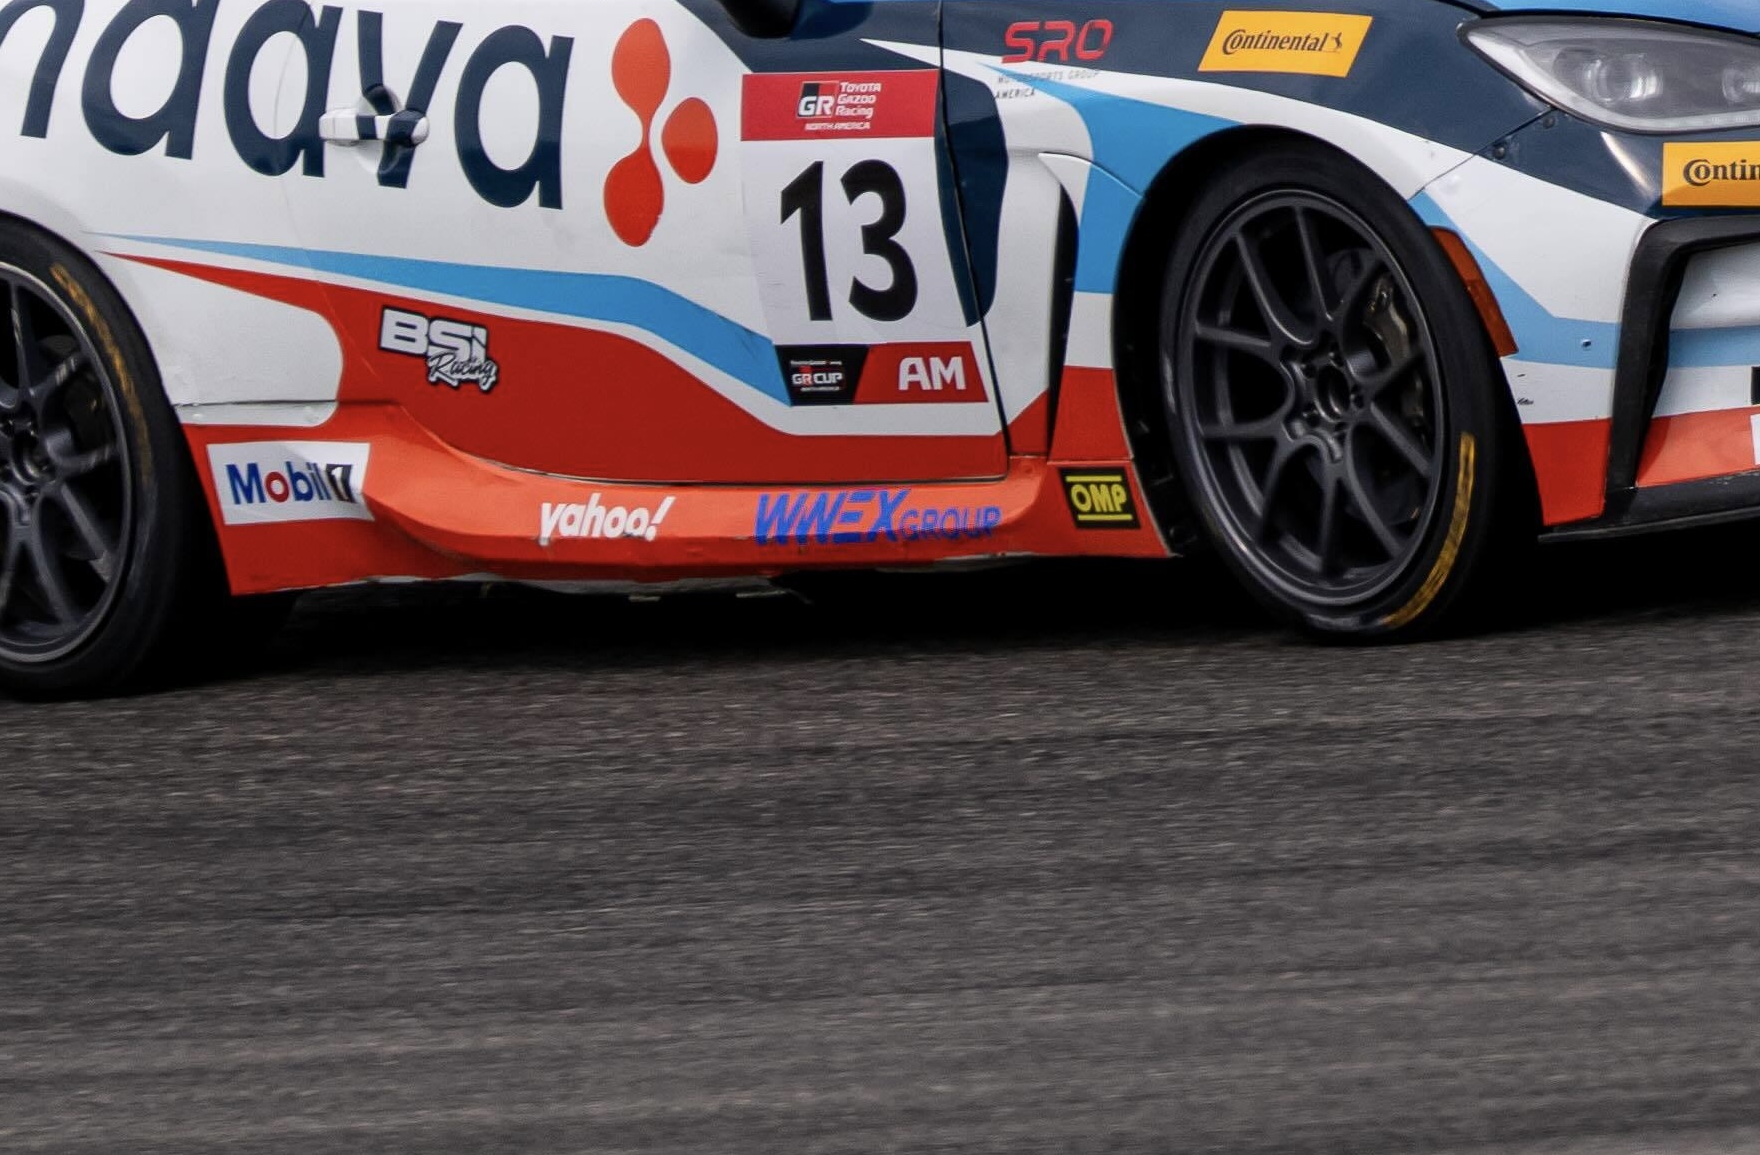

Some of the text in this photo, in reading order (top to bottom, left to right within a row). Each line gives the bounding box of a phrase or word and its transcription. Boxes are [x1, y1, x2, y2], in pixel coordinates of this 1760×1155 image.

[1001, 18, 1114, 64] SRO
[1222, 28, 1330, 56] Continental
[840, 81, 882, 93] TOYOTA
[798, 94, 836, 117] GR
[835, 104, 874, 119] Racing
[779, 158, 919, 323] 13
[813, 372, 843, 384] CUP
[898, 356, 967, 391] AM
[225, 461, 353, 505] Mobil 1
[1070, 483, 1128, 513] OMP
[539, 492, 677, 546] yahoo!
